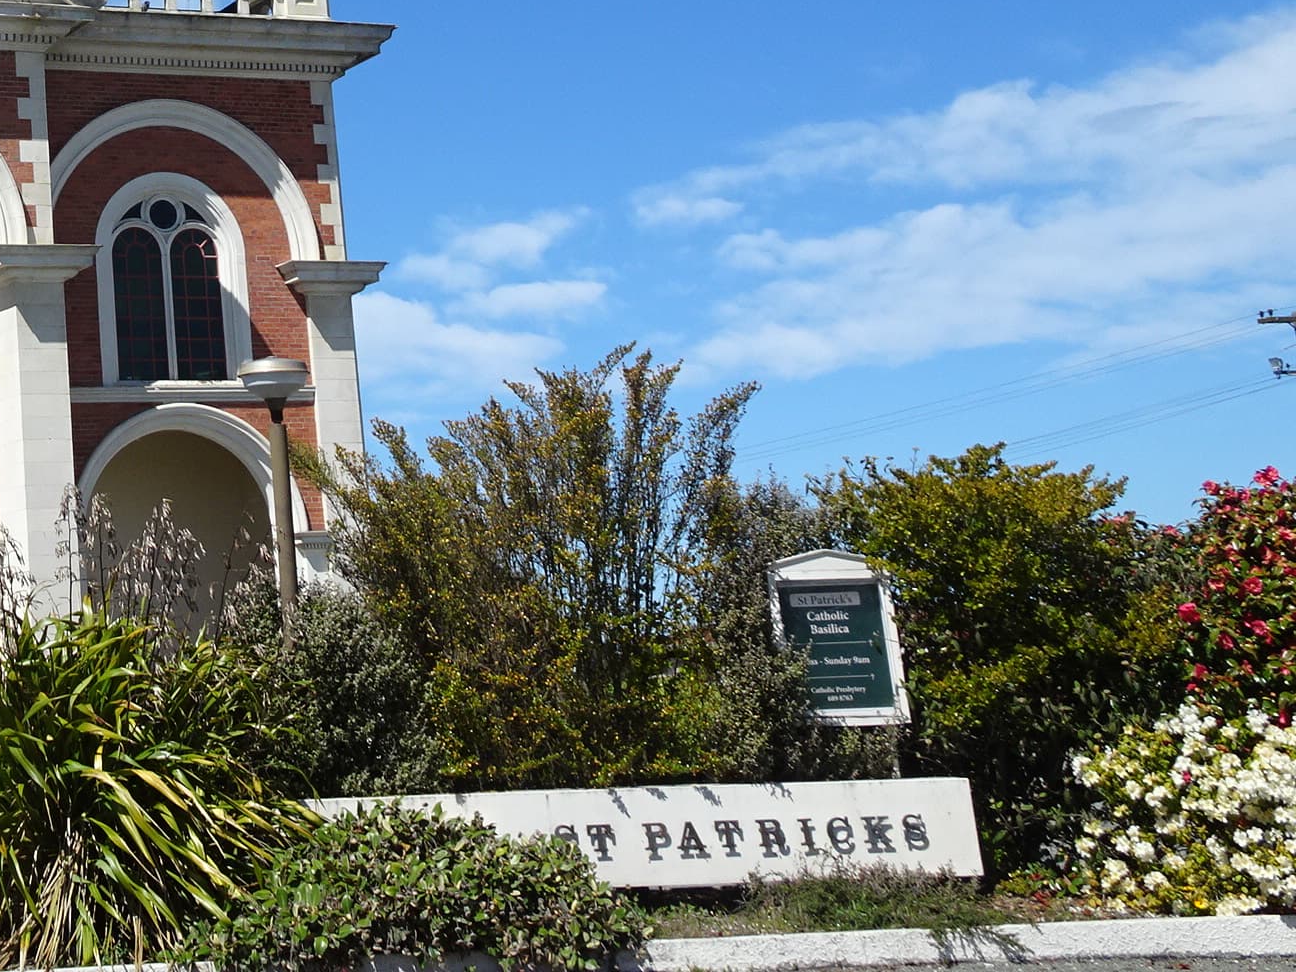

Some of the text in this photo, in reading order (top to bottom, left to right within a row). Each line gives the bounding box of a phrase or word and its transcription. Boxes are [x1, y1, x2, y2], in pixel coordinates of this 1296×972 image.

[797, 596, 809, 606] St
[807, 611, 849, 621] Catholic
[810, 624, 850, 634] Basilica
[824, 656, 852, 666] Sunday
[852, 655, 871, 664] 9am
[642, 813, 930, 860] PATRICKS
